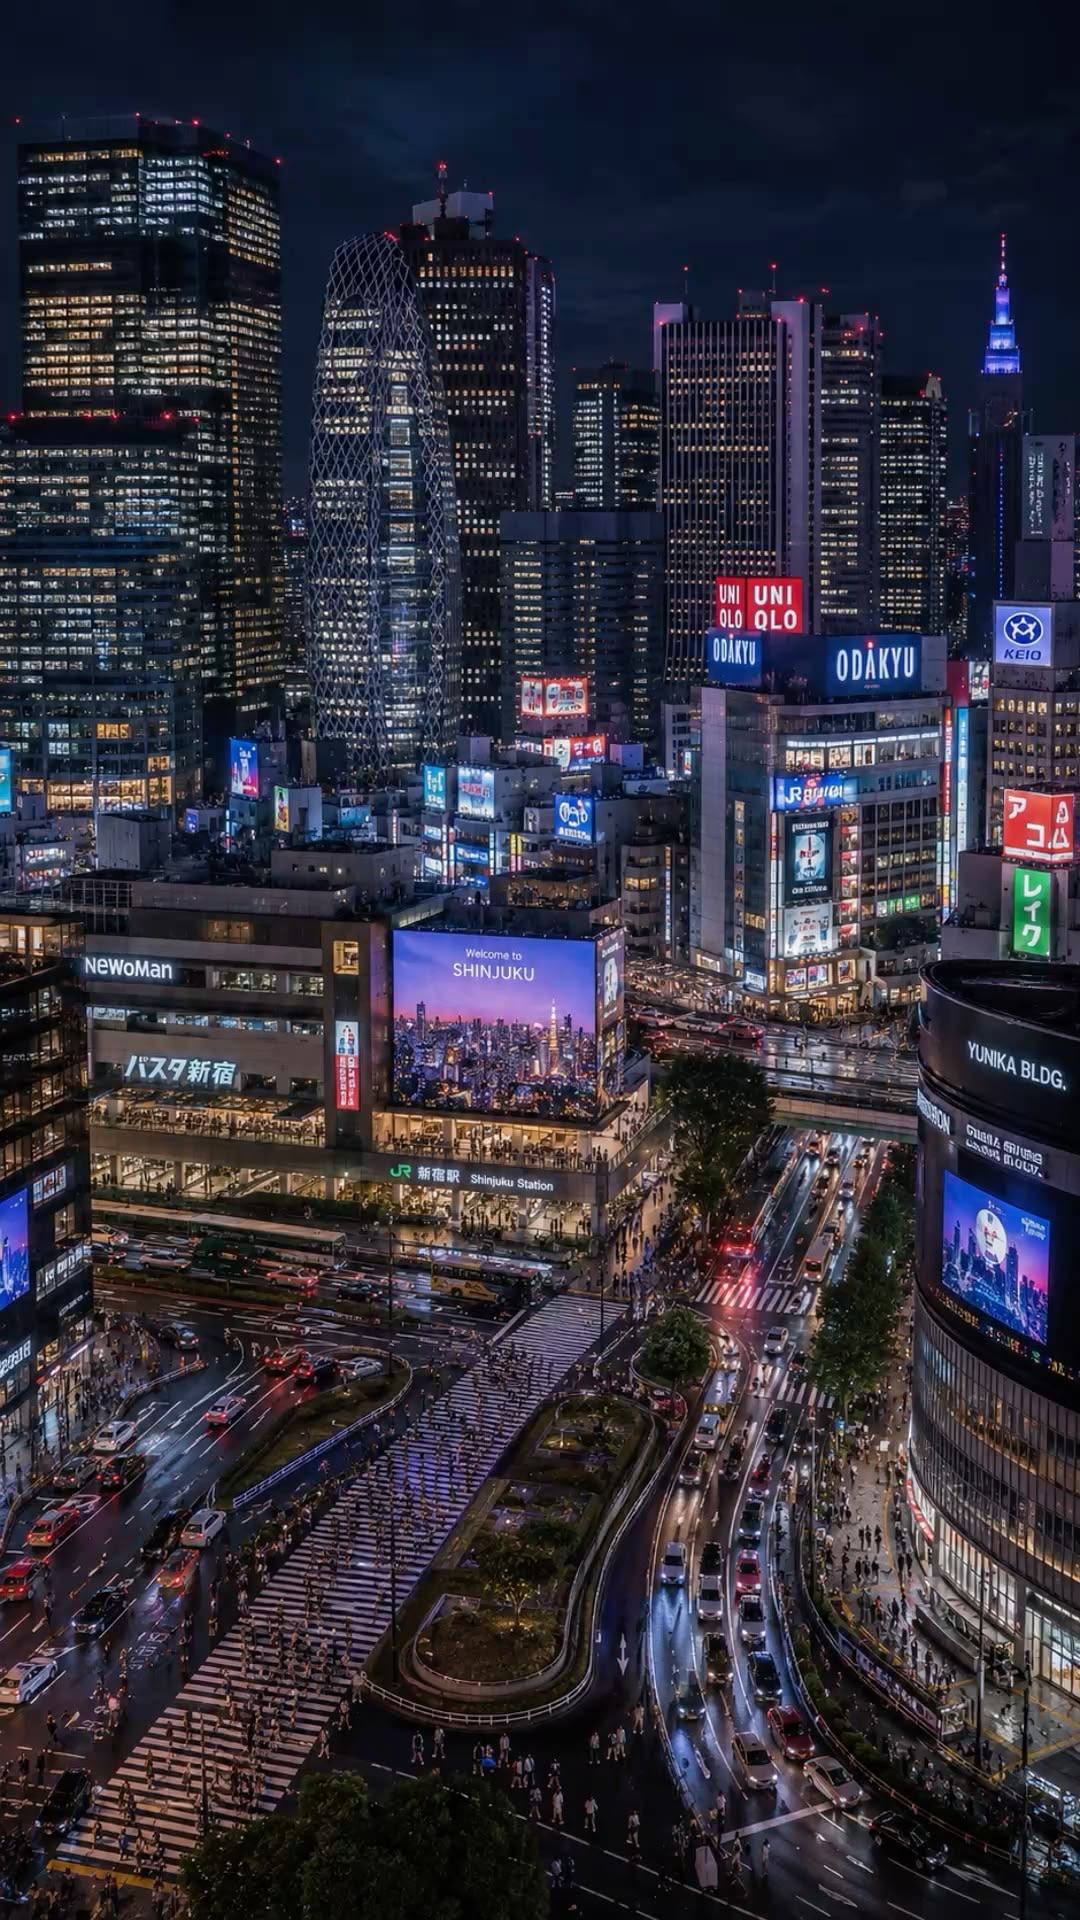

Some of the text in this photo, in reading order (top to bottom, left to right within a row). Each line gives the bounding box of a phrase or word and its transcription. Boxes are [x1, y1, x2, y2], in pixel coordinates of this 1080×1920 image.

[719, 584, 740, 604] UNI
[754, 585, 792, 605] UNI
[719, 608, 743, 629] QLO
[754, 609, 797, 632] QLO
[713, 636, 756, 666] ODAKYU
[1004, 648, 1042, 661] KEIO
[836, 646, 915, 682] ODAKYU
[1021, 874, 1042, 947] レイク
[465, 948, 522, 961] Welcome to
[453, 962, 535, 982] SHINJUKU
[967, 1040, 1067, 1091] YUNIKA BLDG.
[389, 1163, 412, 1178] JR
[470, 1174, 514, 1188] Shinjuku
[516, 1178, 554, 1192] Station
